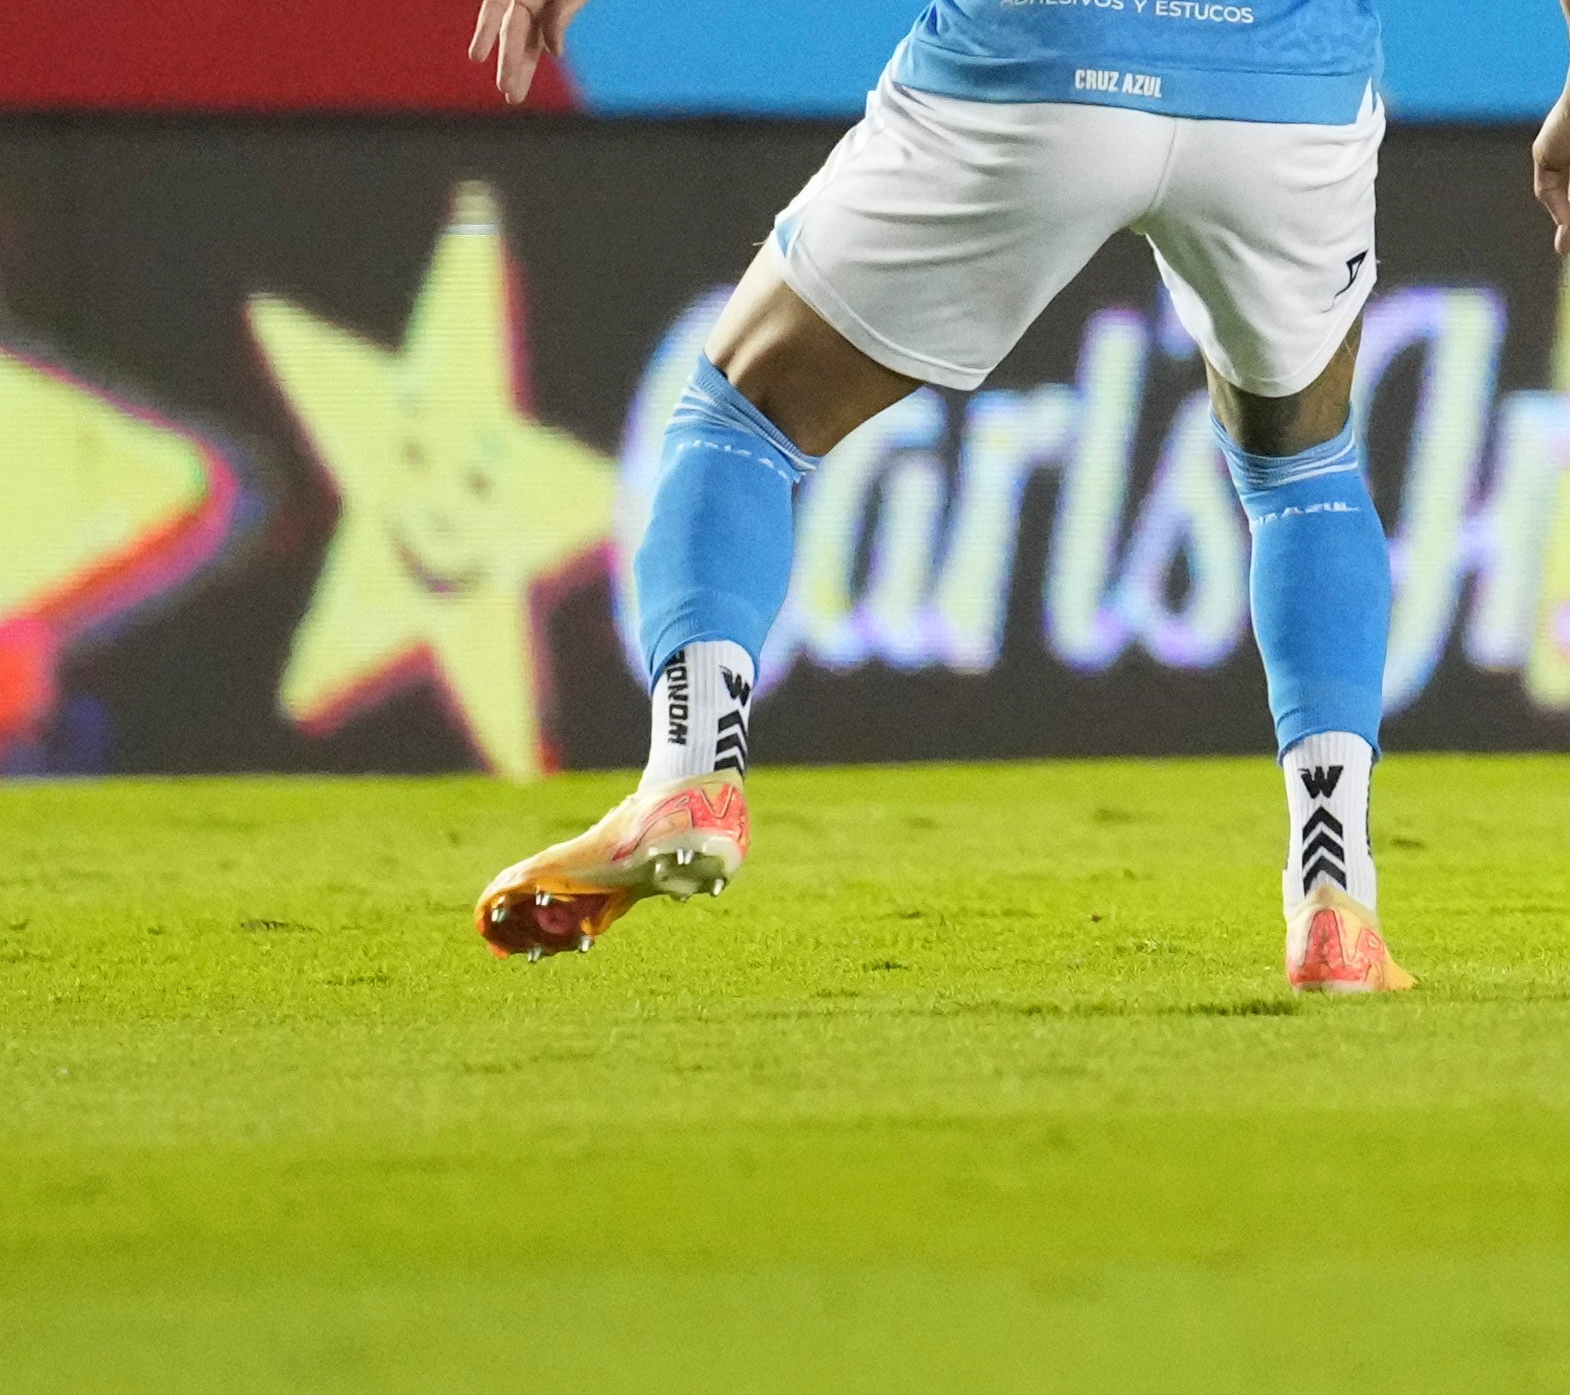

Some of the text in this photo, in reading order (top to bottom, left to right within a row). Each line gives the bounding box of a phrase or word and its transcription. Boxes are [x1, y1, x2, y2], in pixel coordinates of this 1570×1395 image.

[1155, 0, 1254, 24] ESTUCOS
[1074, 69, 1163, 98] CRUZ AZUL
